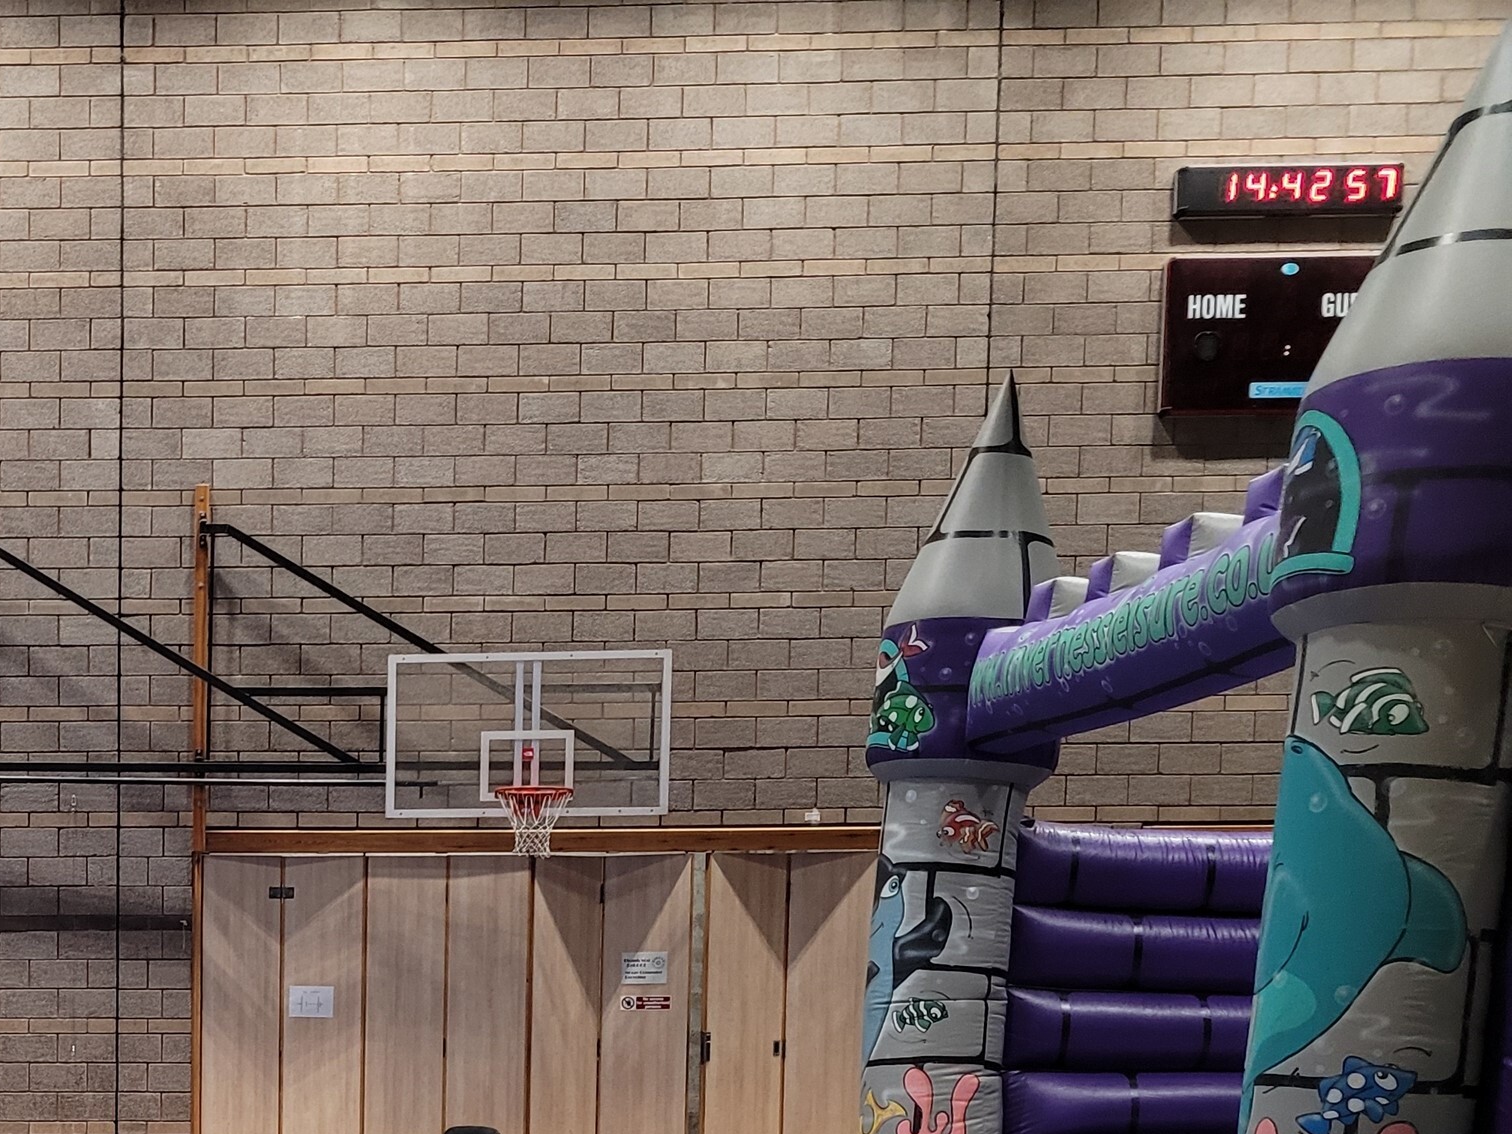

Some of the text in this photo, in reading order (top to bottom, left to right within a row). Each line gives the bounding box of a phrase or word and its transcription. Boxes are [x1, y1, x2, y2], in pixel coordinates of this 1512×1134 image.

[1226, 167, 1398, 203] 14:42 57
[1187, 294, 1247, 319] HOME
